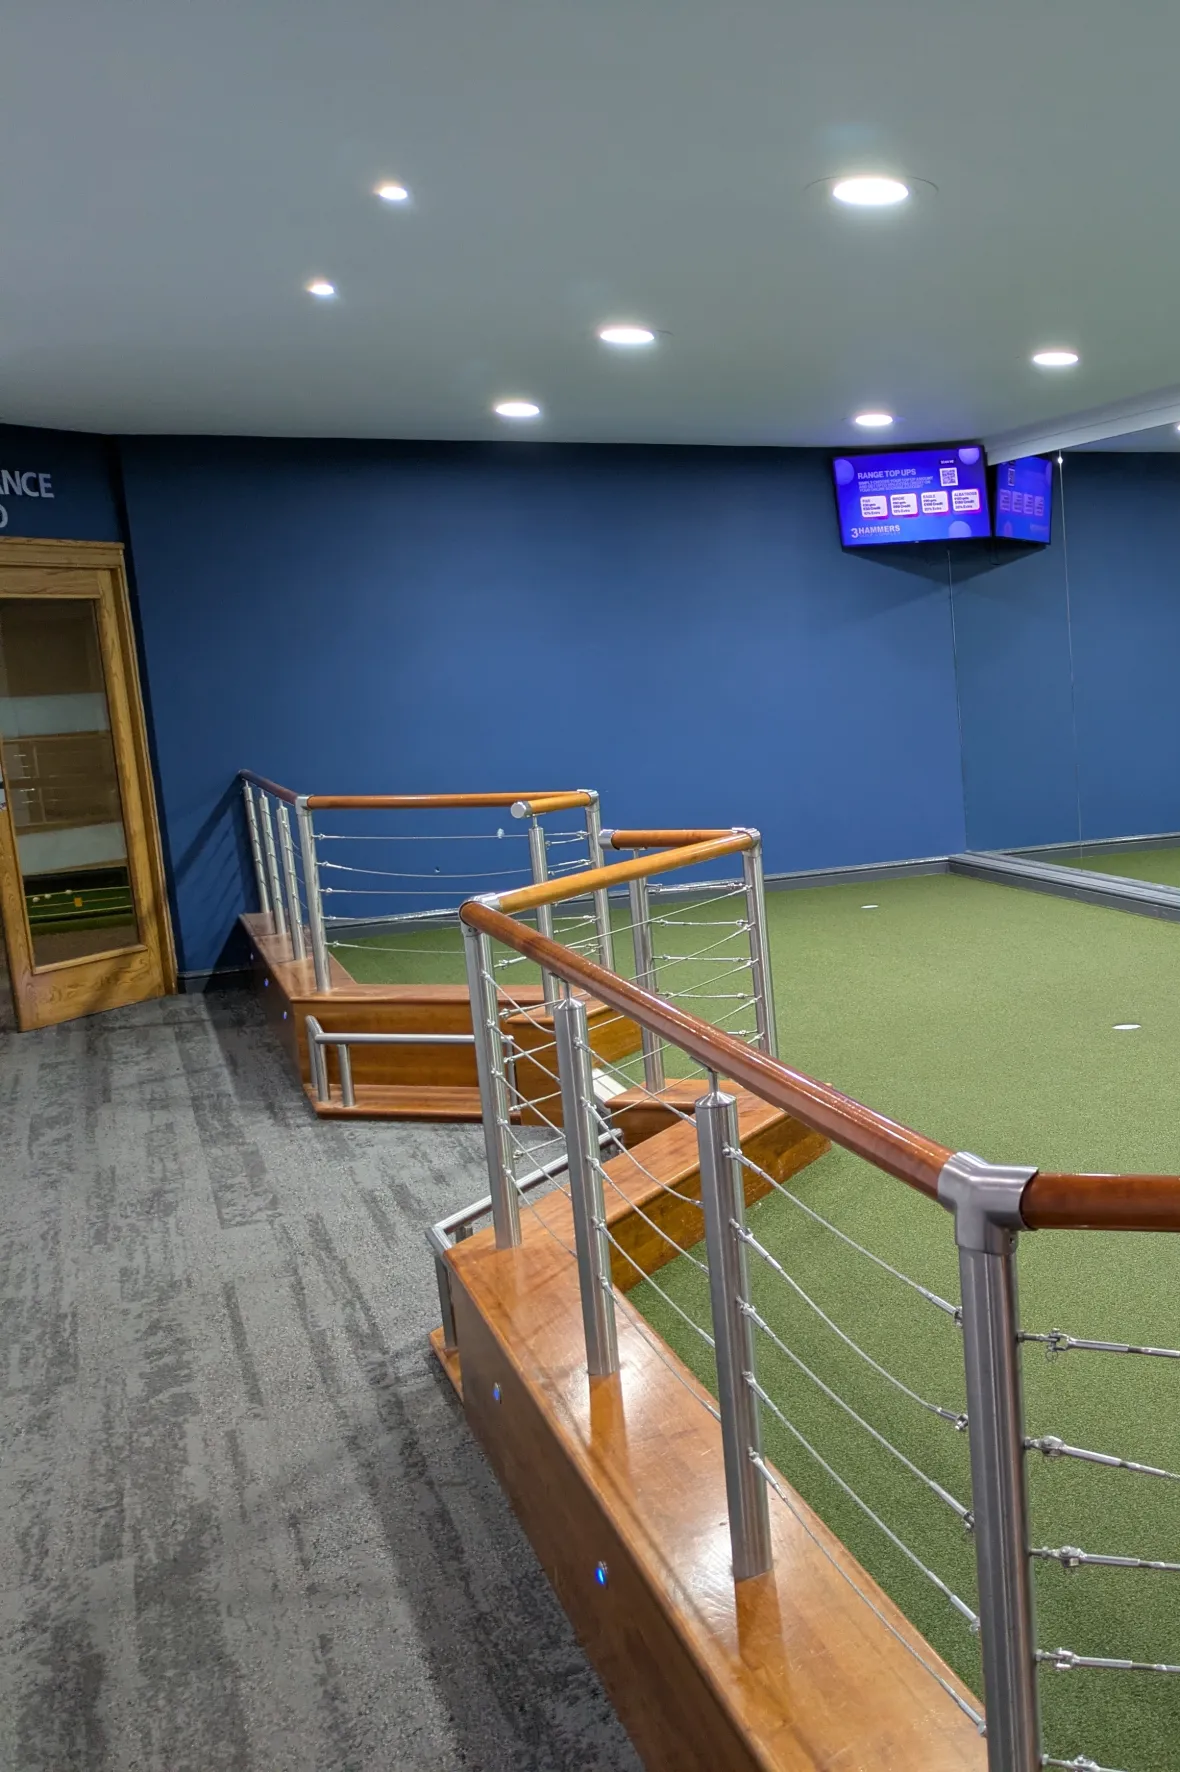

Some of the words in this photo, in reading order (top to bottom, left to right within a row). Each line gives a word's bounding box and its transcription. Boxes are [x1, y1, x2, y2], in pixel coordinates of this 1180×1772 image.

[857, 470, 884, 480] RANGE
[884, 469, 900, 478] TOP
[901, 468, 917, 477] UPS
[0, 469, 55, 498] NCE
[850, 527, 859, 539] 3
[858, 524, 901, 535] HAMMERS
